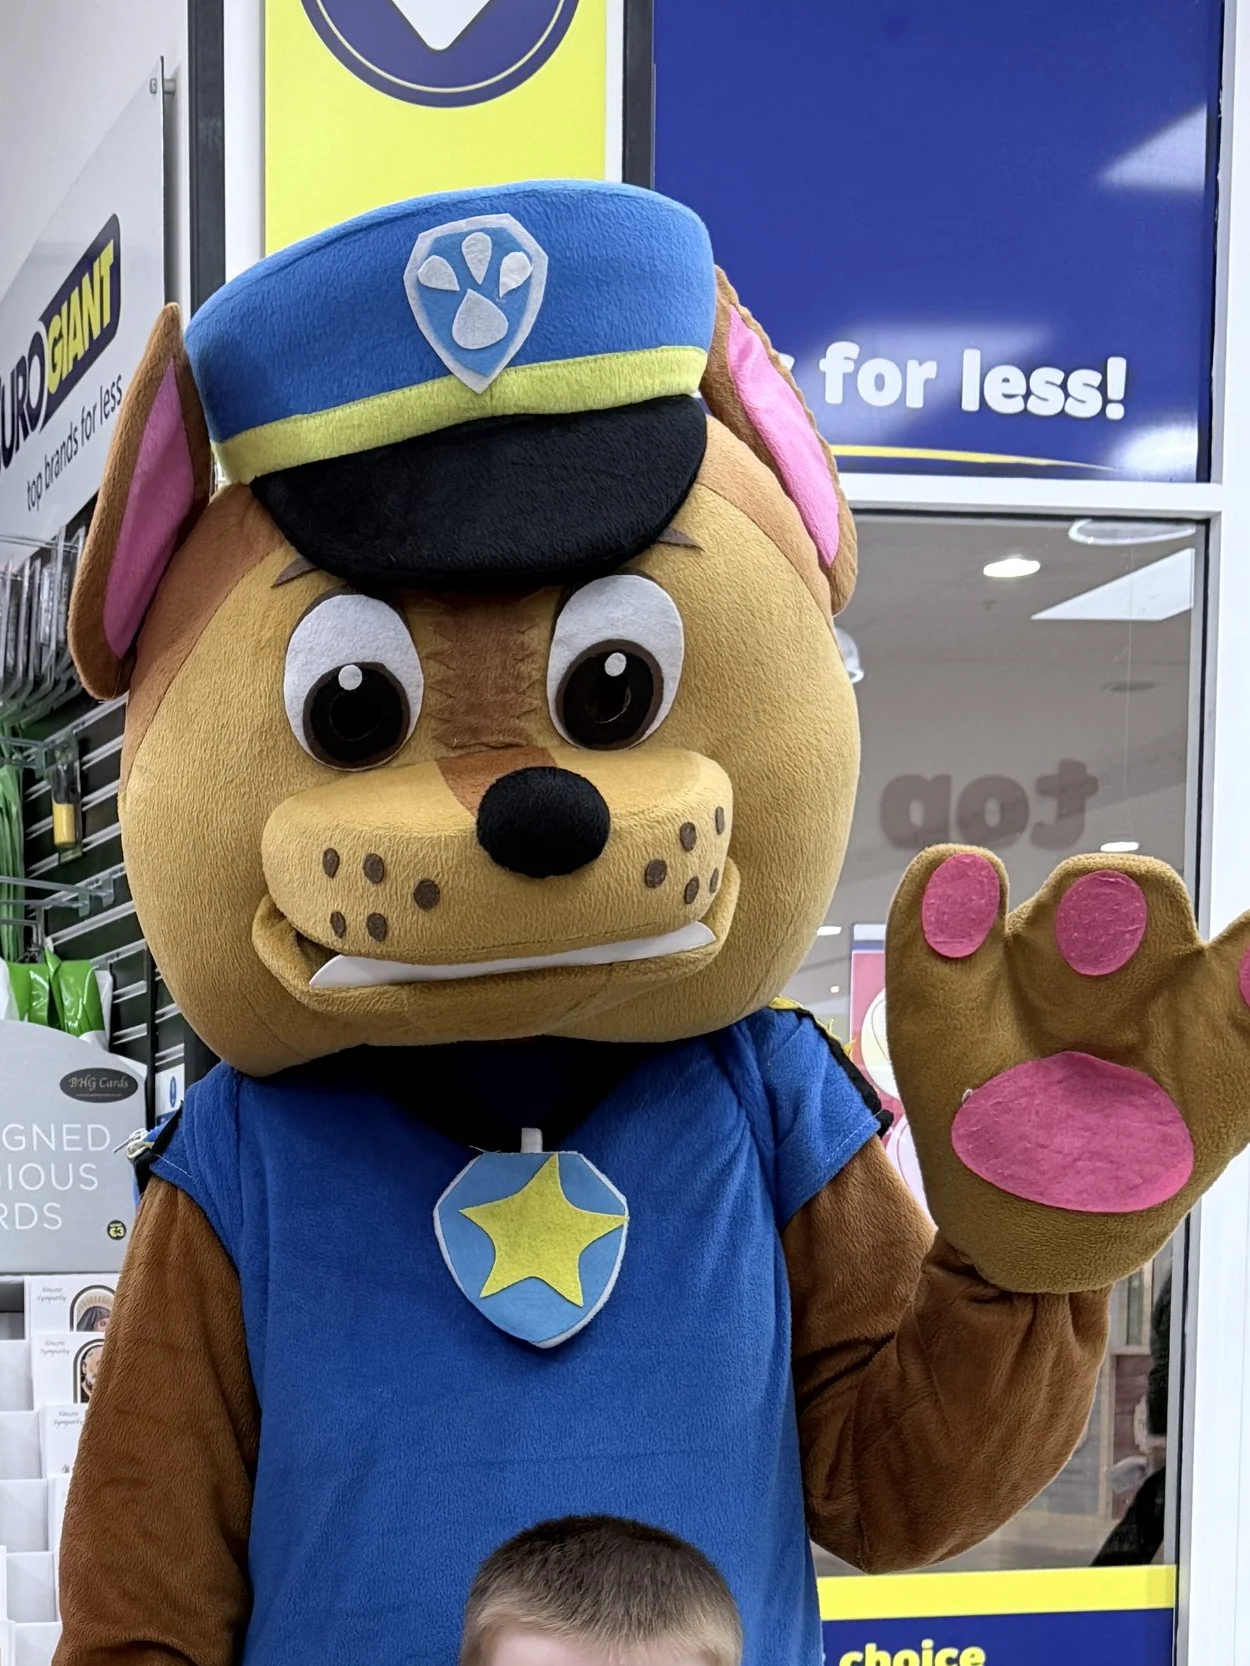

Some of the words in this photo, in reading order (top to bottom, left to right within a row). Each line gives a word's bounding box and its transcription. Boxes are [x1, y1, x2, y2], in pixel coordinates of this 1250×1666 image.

[819, 340, 937, 409] for
[960, 347, 1128, 421] less!
[27, 472, 43, 512] top
[45, 422, 78, 491] brands
[81, 403, 97, 447] for
[99, 374, 123, 425] less
[98, 1075, 129, 1088] Cards
